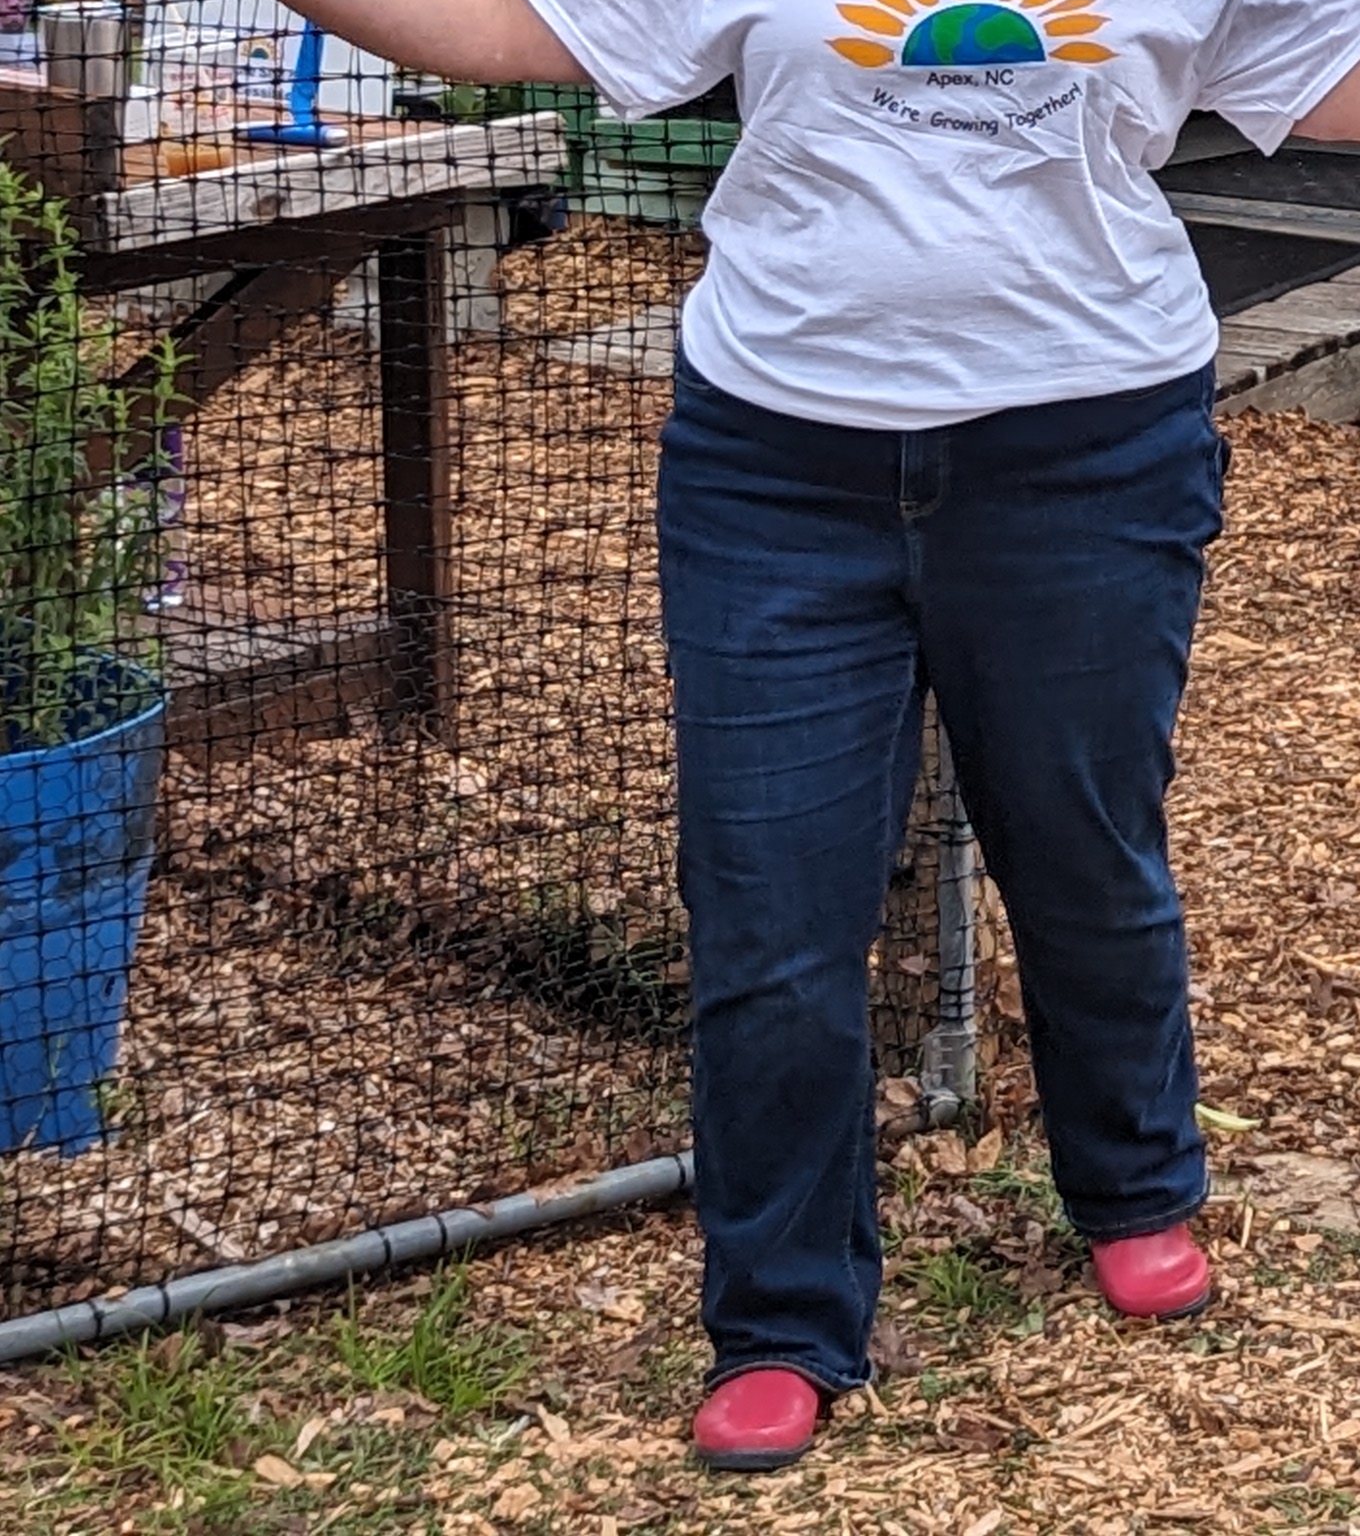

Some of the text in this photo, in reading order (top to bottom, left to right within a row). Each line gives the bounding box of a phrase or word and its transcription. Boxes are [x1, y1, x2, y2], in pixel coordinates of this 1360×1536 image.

[926, 68, 1014, 88] Apex, NC
[872, 87, 920, 122] We're
[930, 111, 999, 137] Growing
